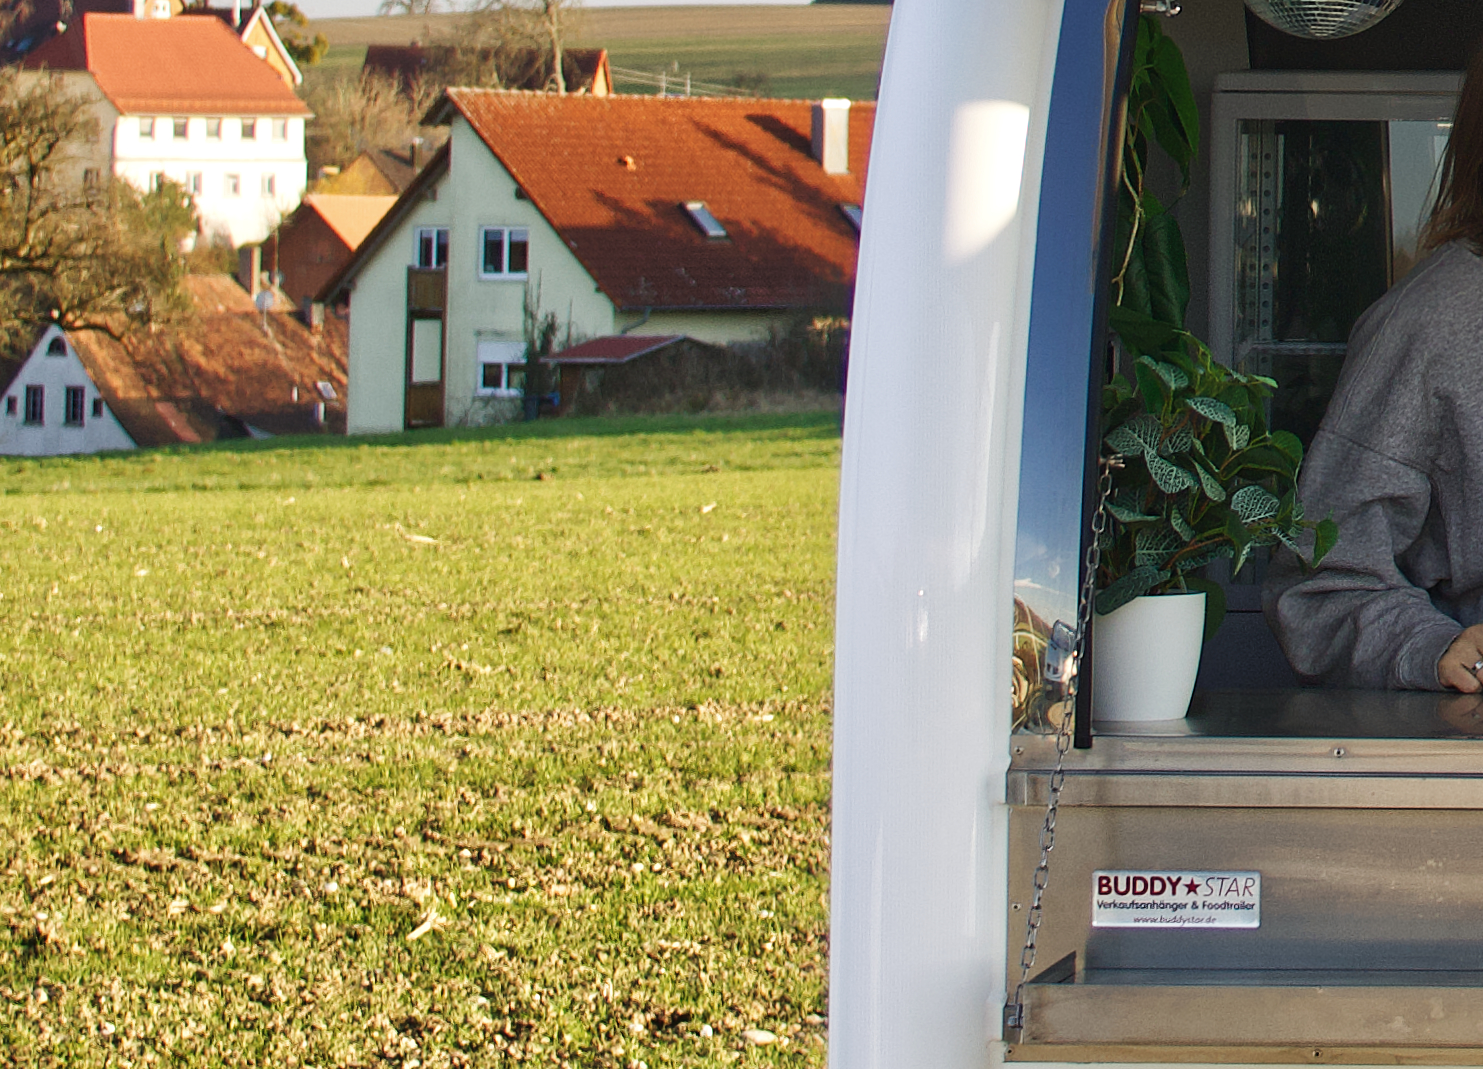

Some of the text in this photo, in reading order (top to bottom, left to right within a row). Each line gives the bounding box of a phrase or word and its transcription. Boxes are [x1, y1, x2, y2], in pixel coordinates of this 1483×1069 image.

[1097, 875, 1256, 897] BUDDY STAR
[1096, 899, 1256, 912] Verkaufsanhänger & Foodtrailer
[1133, 915, 1217, 926] www.buddystar.de
